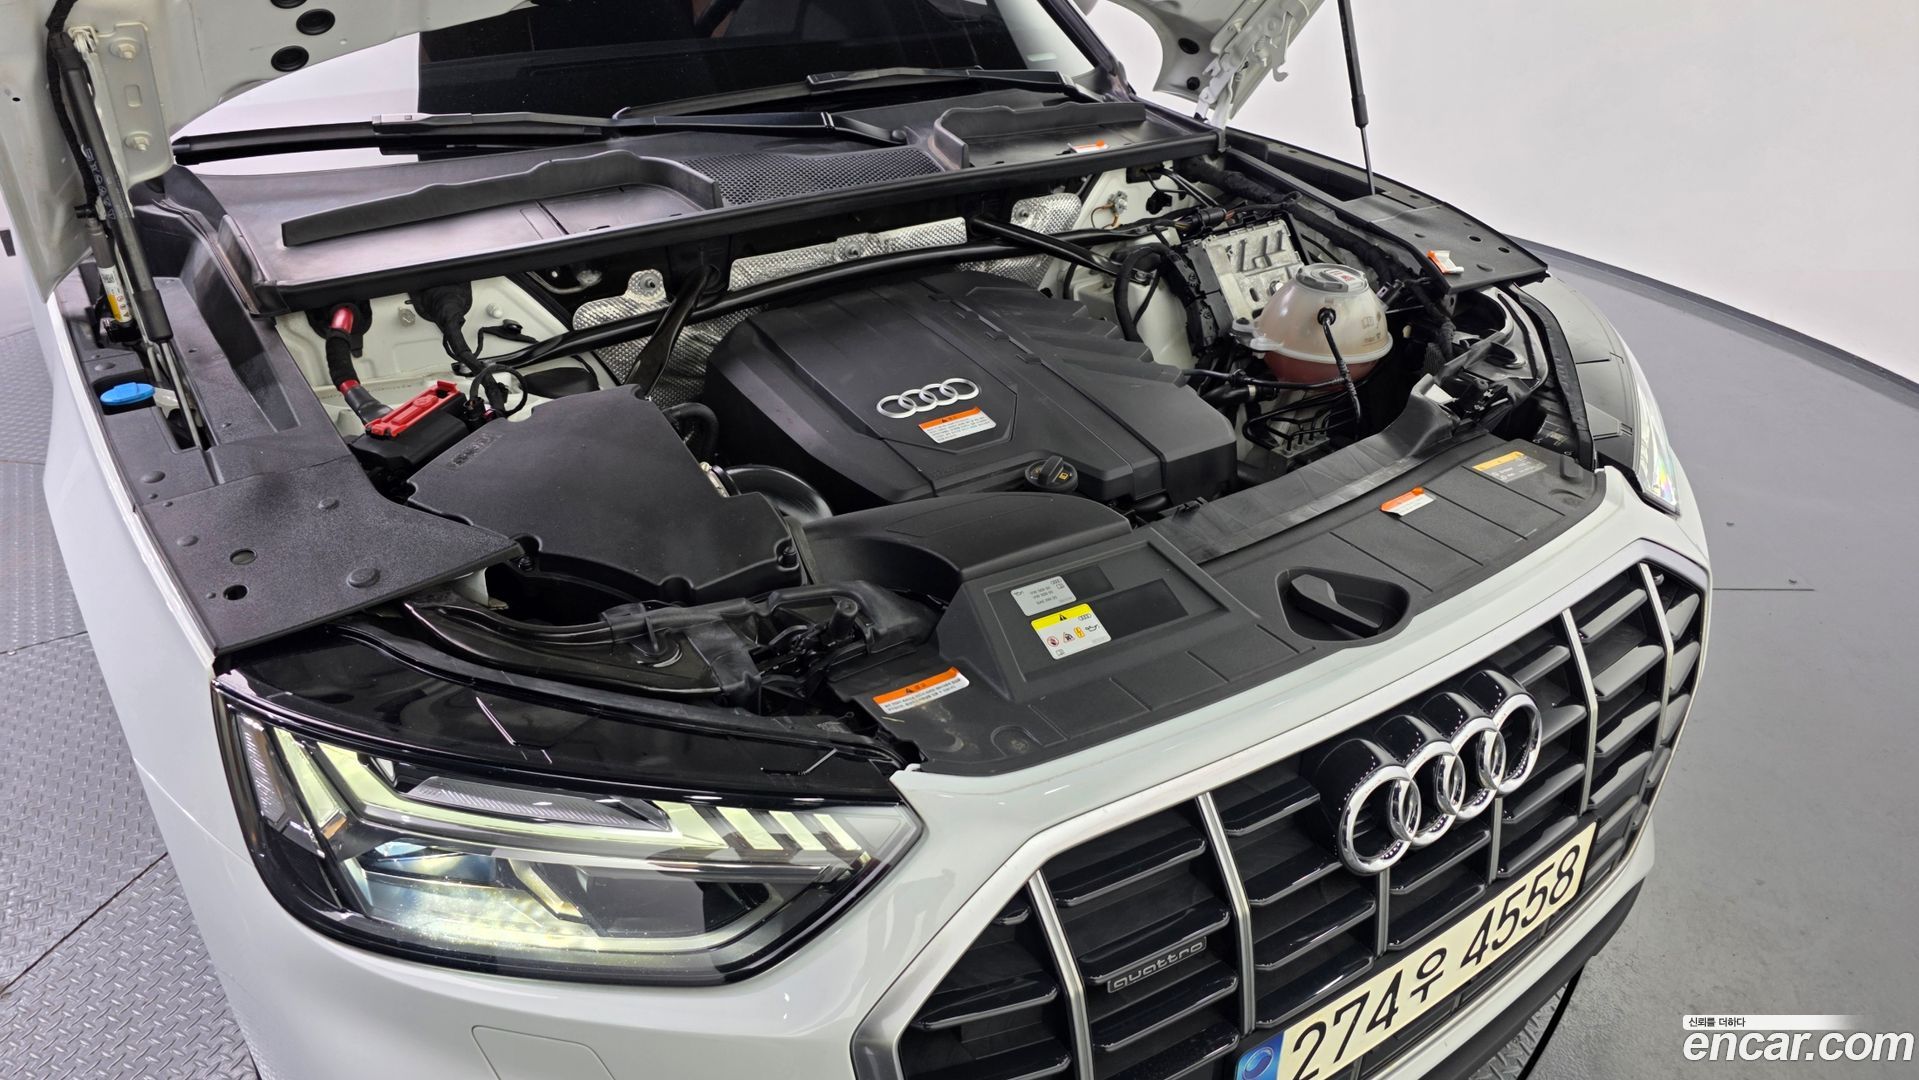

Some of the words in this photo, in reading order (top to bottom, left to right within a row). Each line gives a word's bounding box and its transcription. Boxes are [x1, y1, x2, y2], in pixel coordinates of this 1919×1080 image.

[1113, 942, 1203, 989] quattro
[1292, 947, 1447, 1080] 274우
[1460, 844, 1581, 969] 4558
